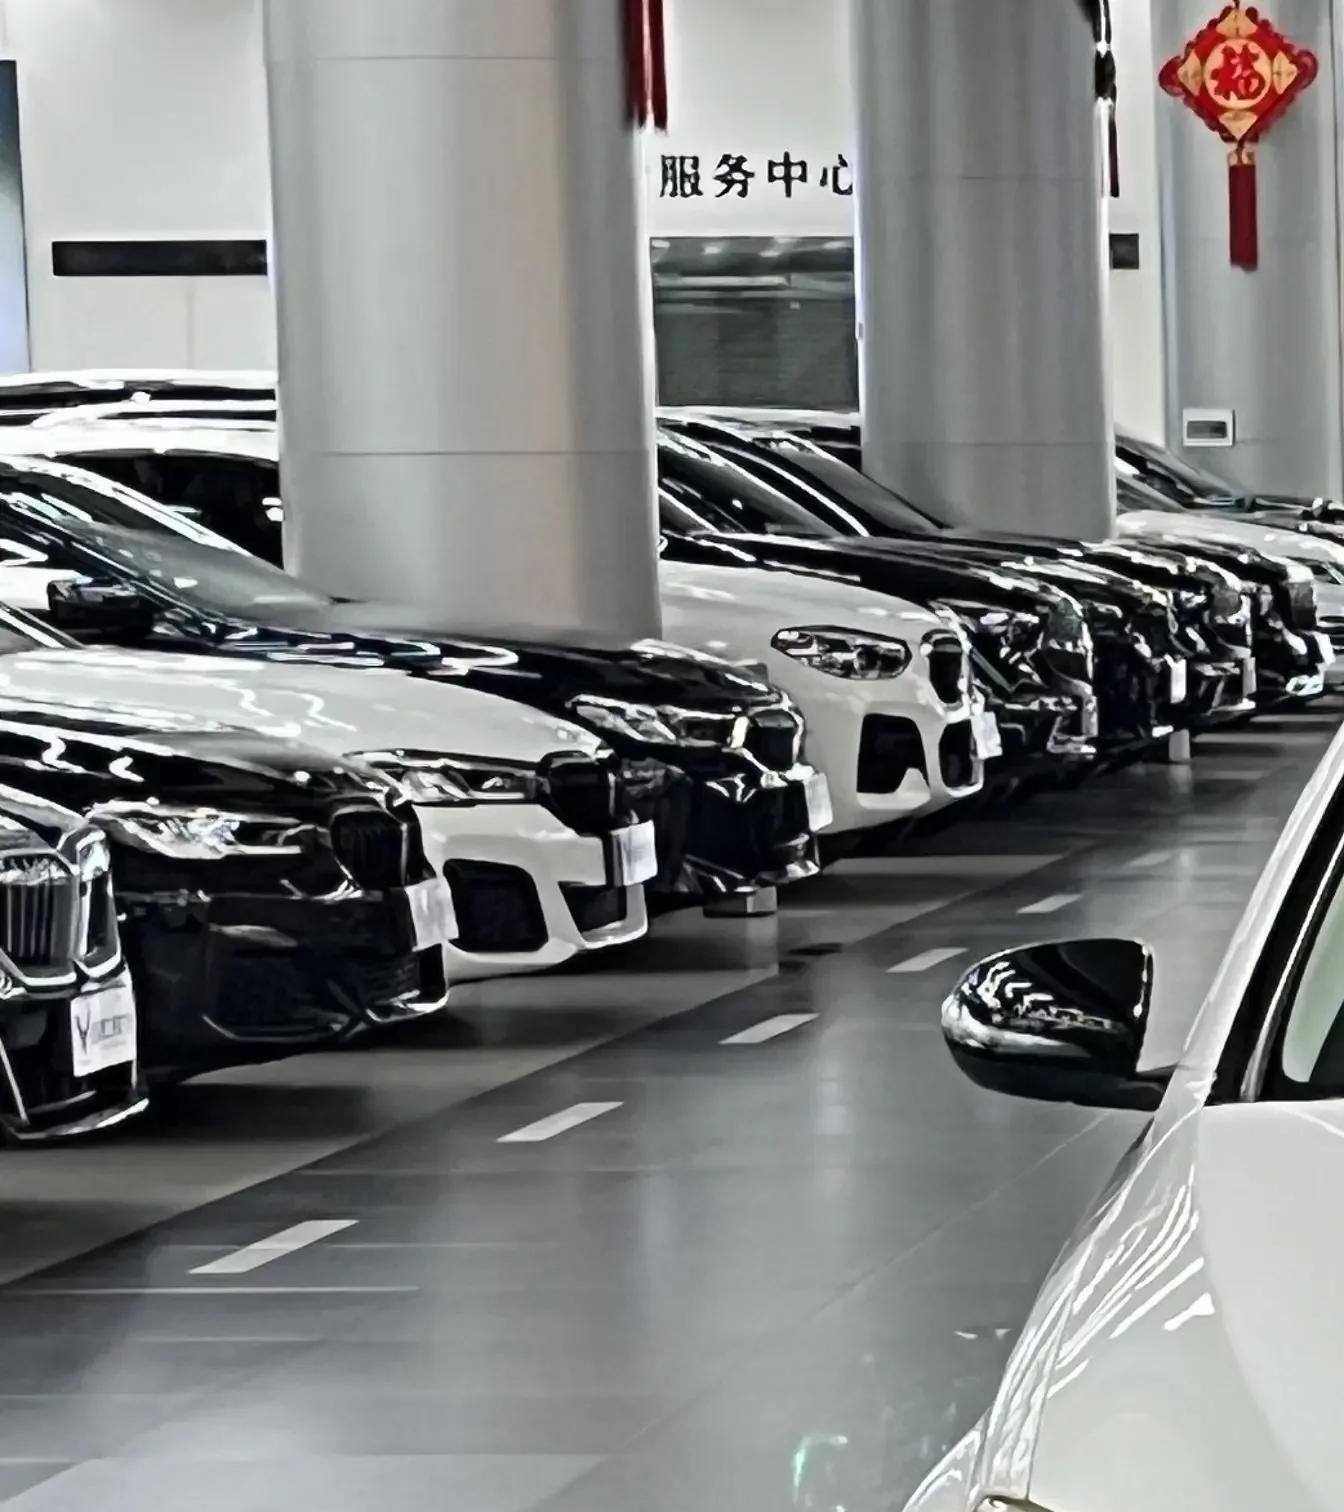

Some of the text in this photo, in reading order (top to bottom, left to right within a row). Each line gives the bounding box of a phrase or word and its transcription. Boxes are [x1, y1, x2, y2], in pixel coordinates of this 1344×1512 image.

[1210, 44, 1266, 101] 福
[660, 151, 853, 198] 服务中心
